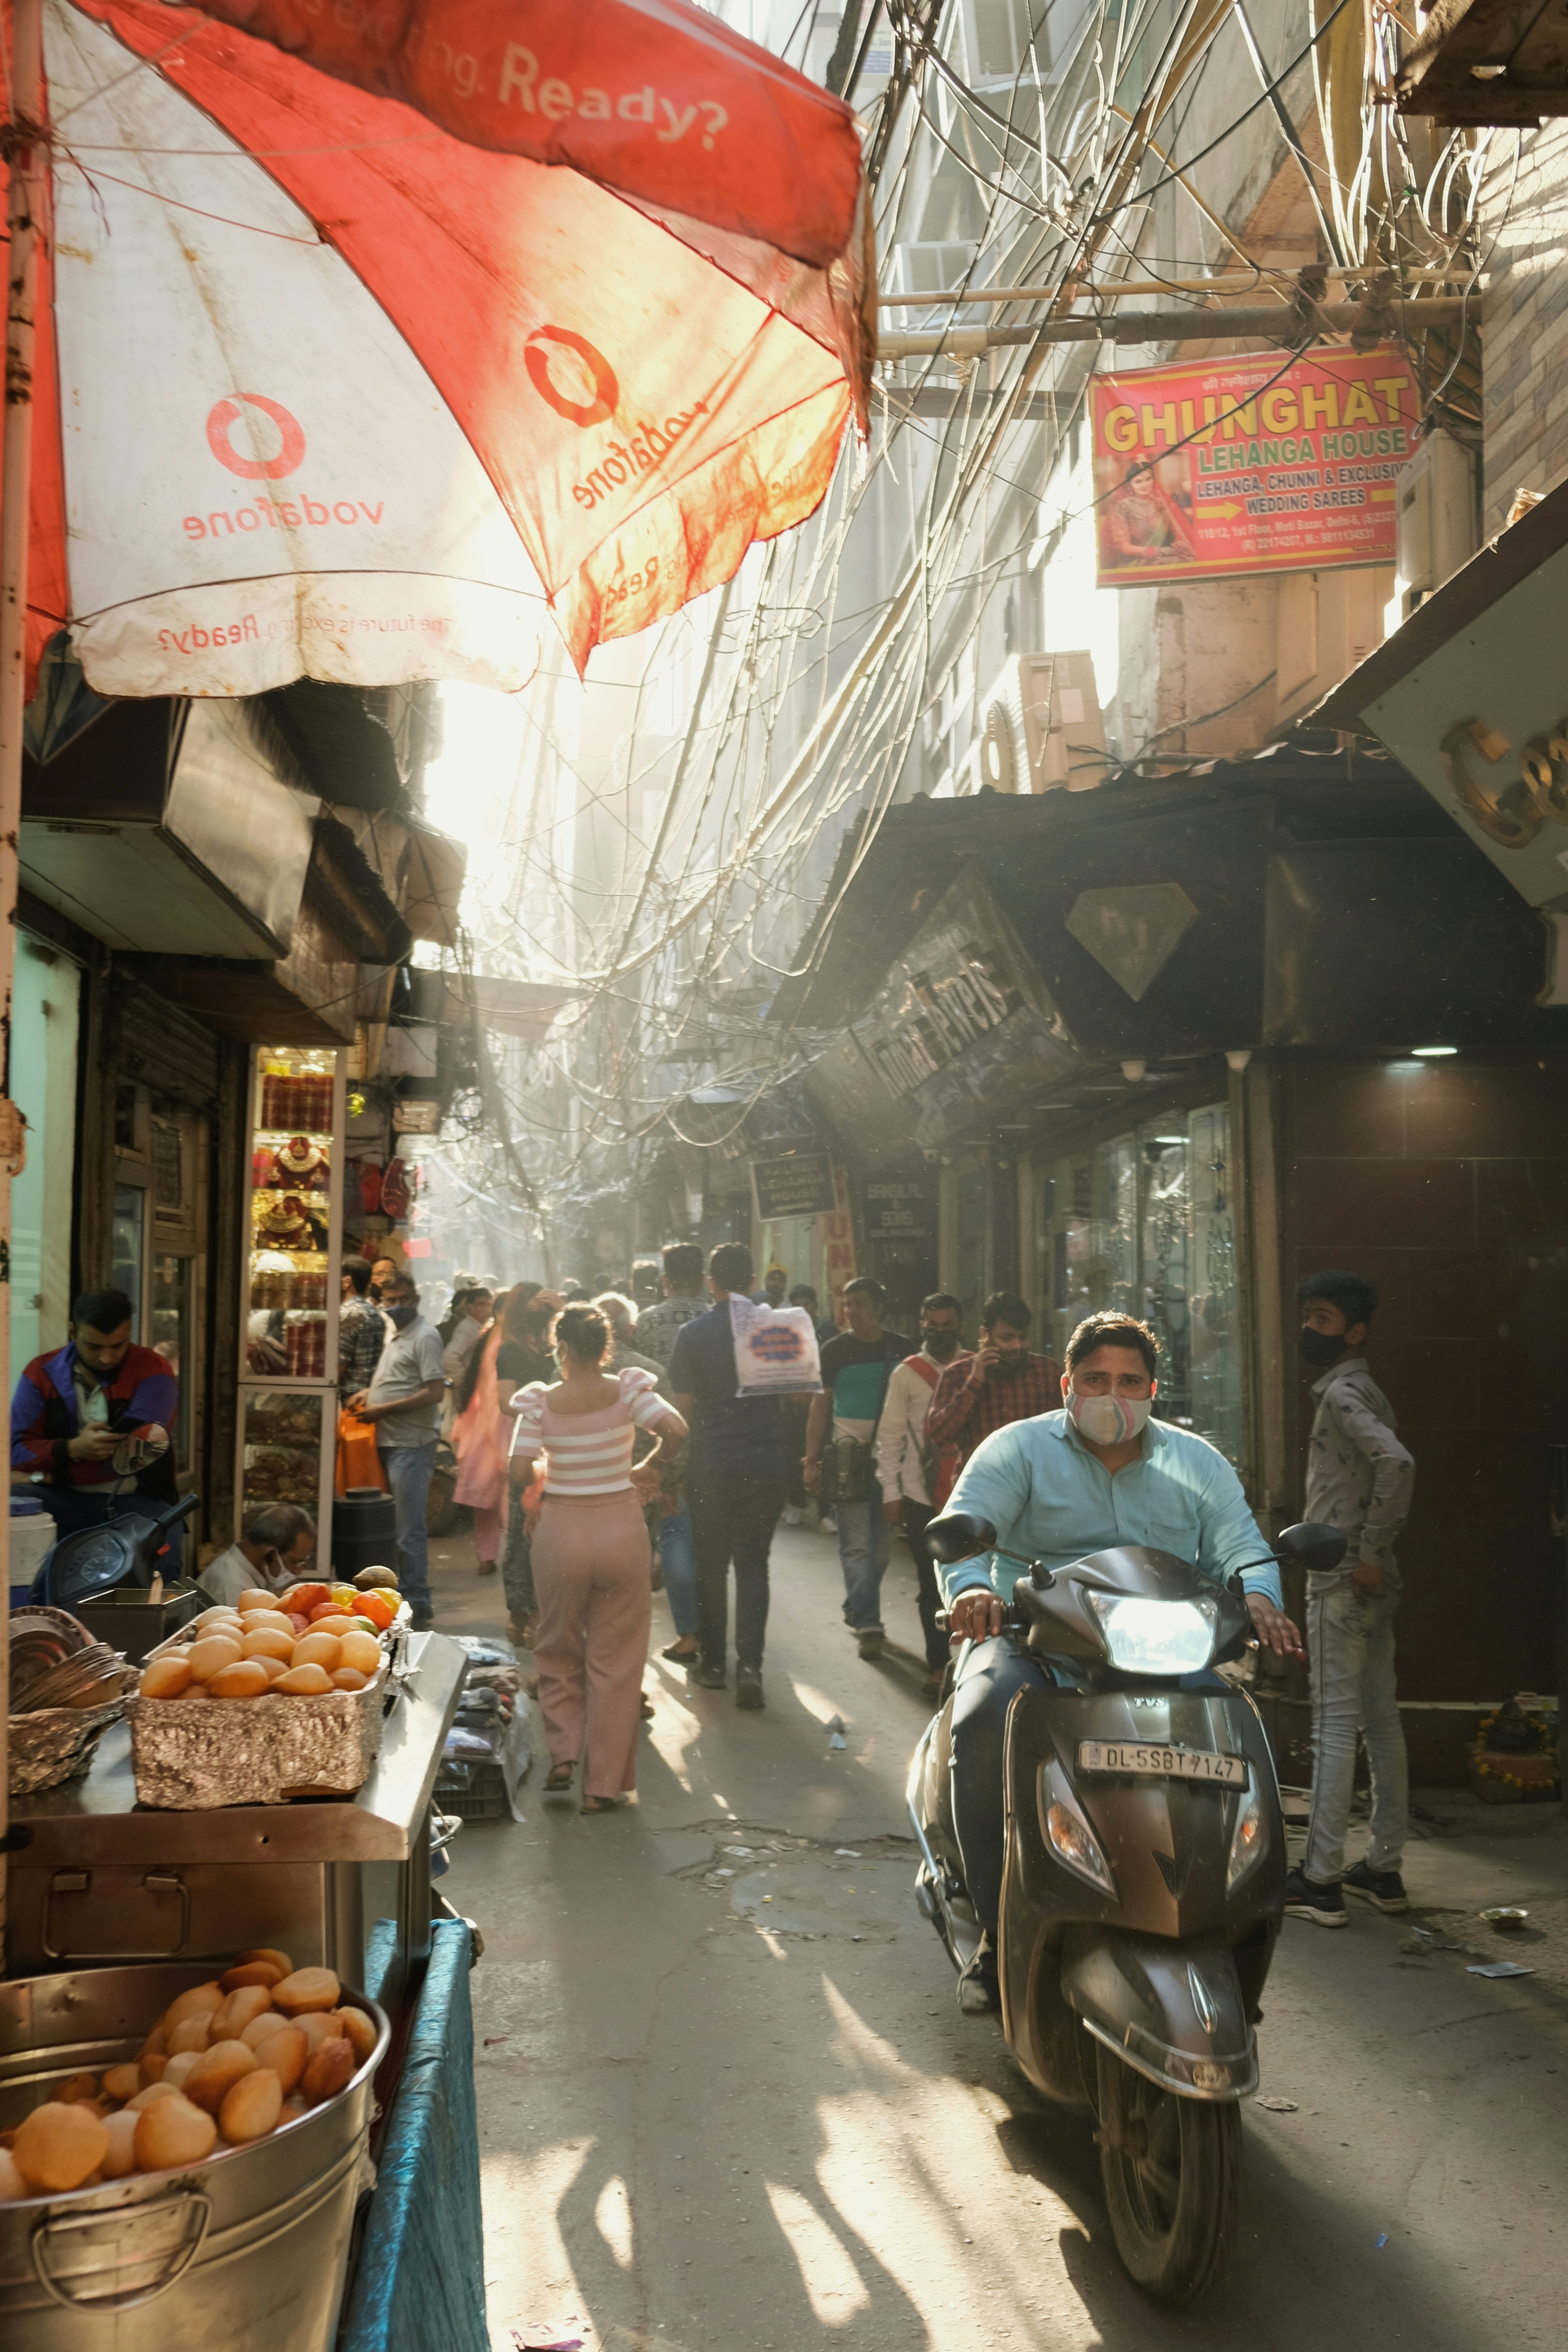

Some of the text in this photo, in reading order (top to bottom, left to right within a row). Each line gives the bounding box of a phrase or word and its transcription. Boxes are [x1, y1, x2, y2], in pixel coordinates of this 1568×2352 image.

[497, 40, 730, 152] Ready?
[1104, 377, 1410, 453] GHUNGHAT
[1199, 428, 1409, 475] LEHANGA HOUSE
[1196, 461, 1410, 500] LEHANGA, CHUNNI & EXCLUSIV
[1246, 488, 1366, 517] WEDDING SAREES
[1232, 526, 1246, 537] 1st
[1248, 524, 1273, 534] Floor,
[900, 949, 1009, 1057] Jewels
[770, 1187, 820, 1202] HOUSE
[1134, 1697, 1165, 1709] TVS
